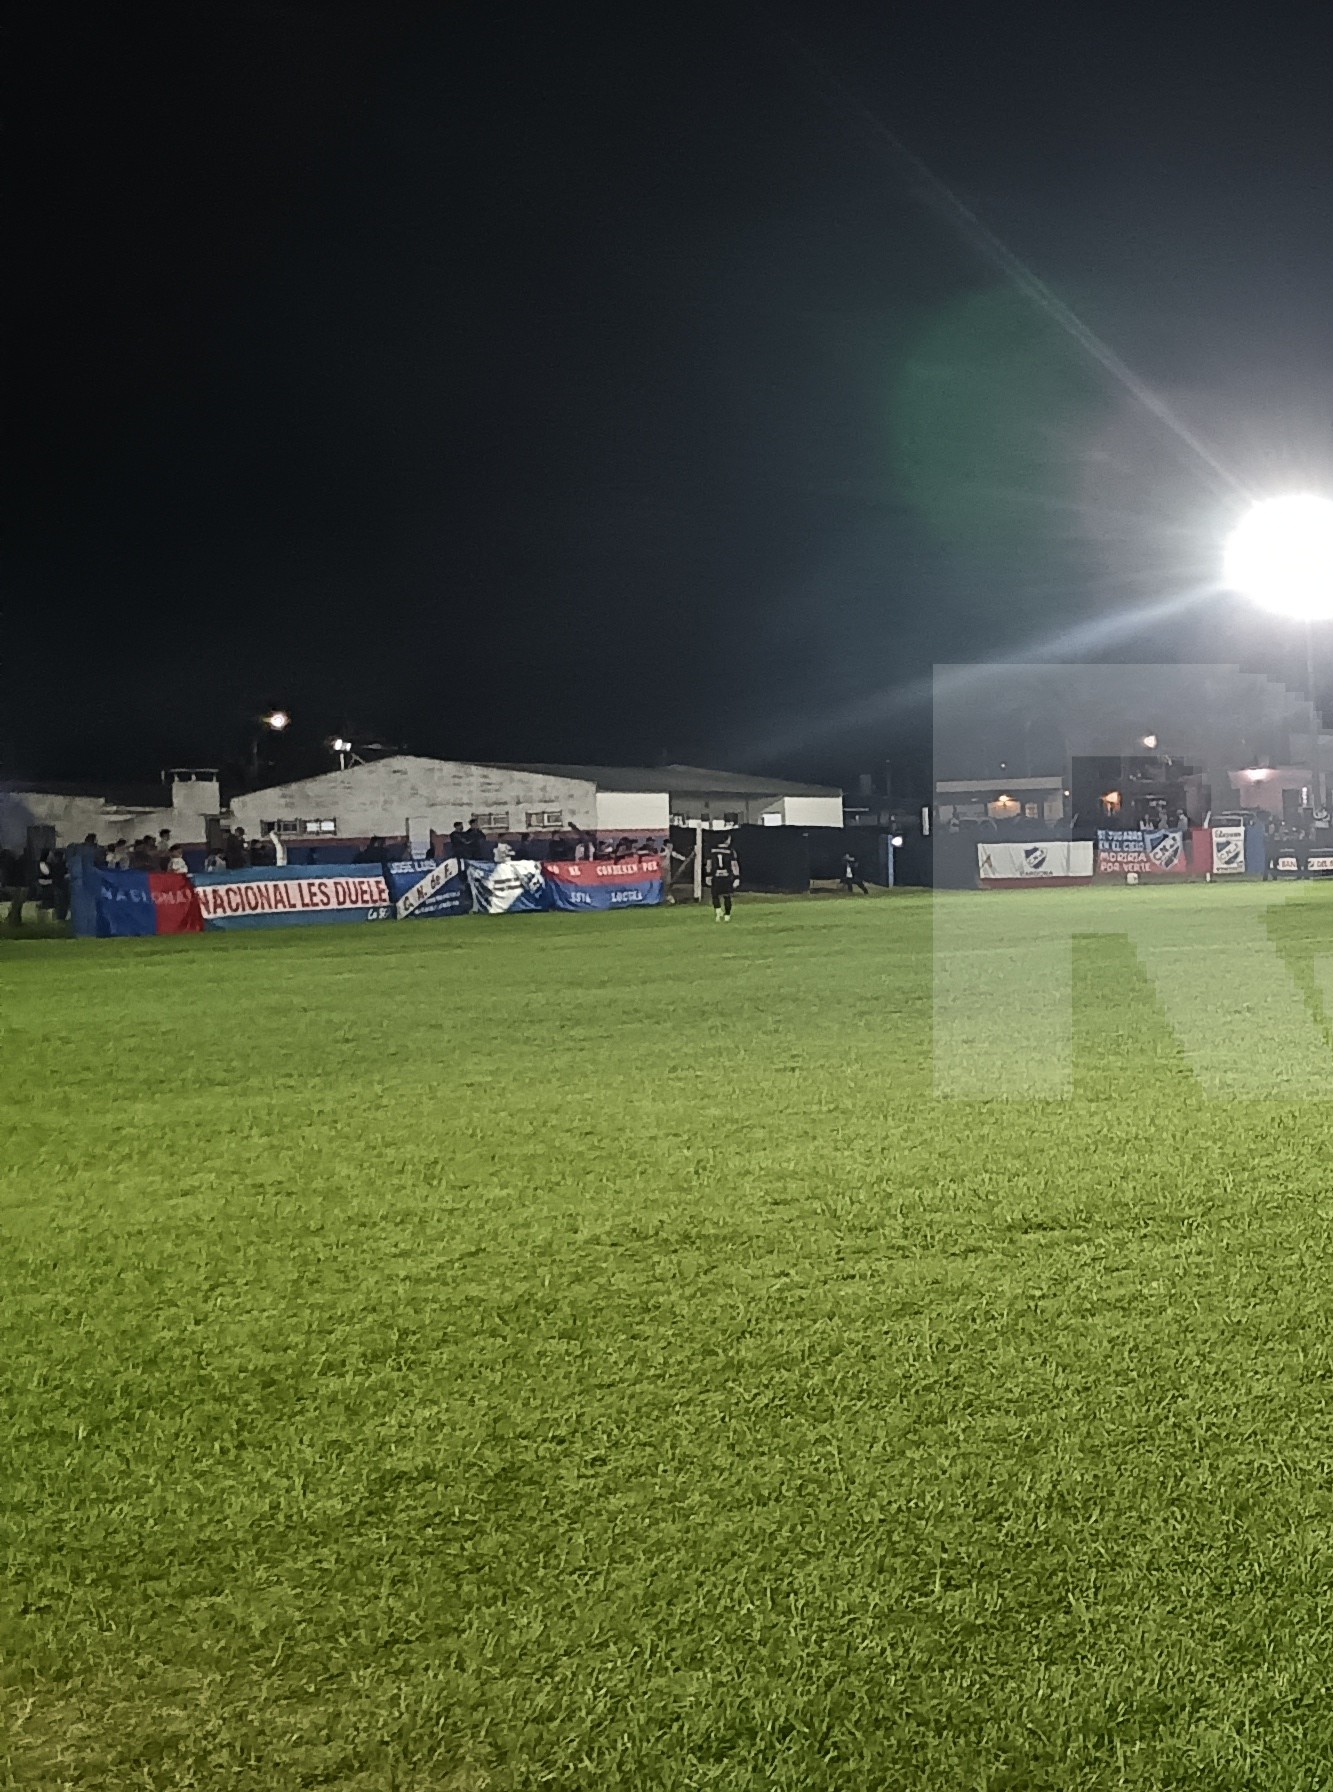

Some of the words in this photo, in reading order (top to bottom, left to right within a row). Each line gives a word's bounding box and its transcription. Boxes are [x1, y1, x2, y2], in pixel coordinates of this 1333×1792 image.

[1101, 862, 1120, 872] POR
[1122, 861, 1151, 873] VERTE
[196, 882, 297, 916] NACIONAL
[299, 881, 332, 908] LES
[333, 879, 388, 907] DUELE
